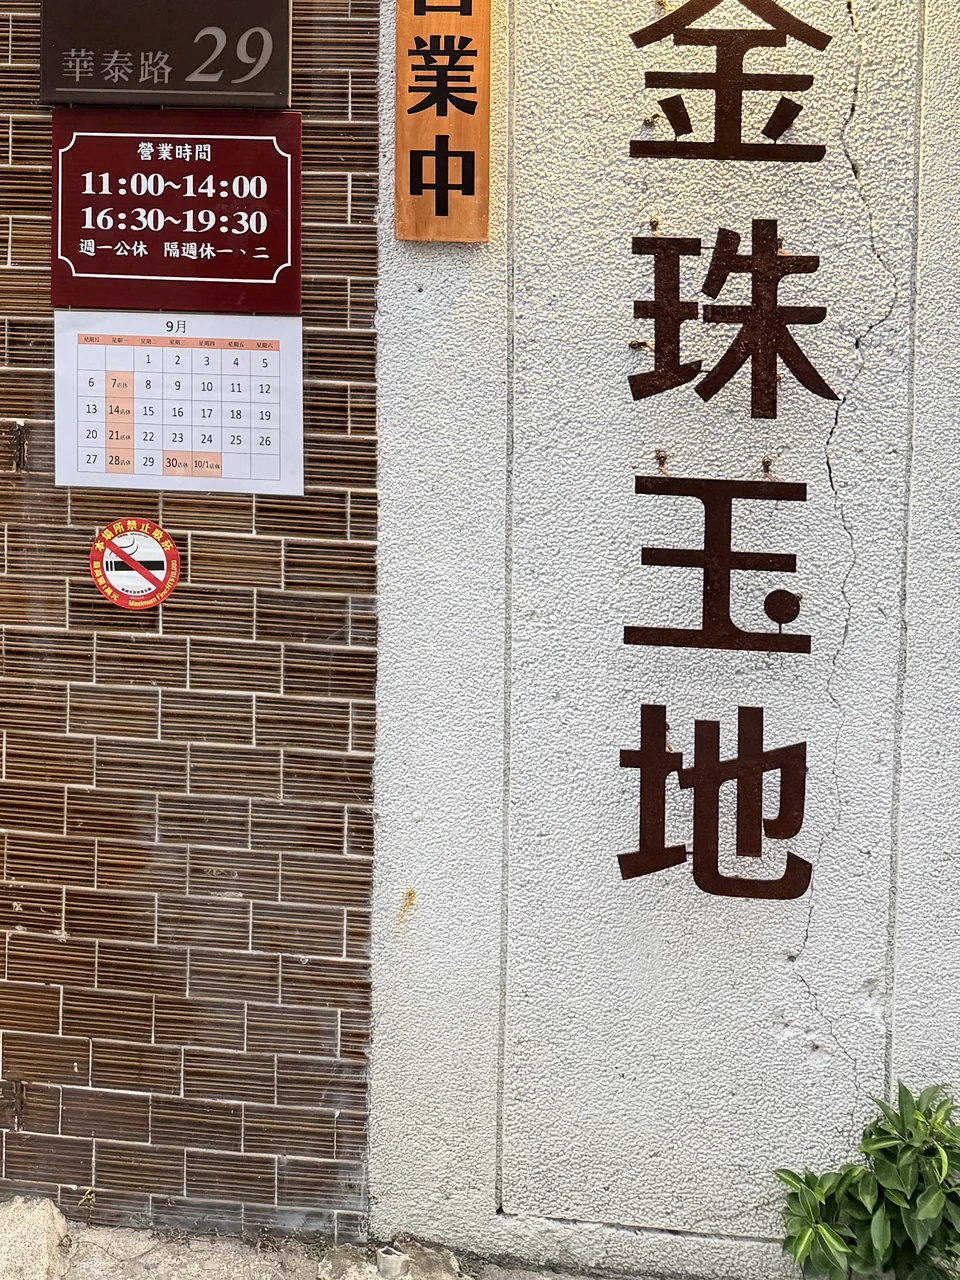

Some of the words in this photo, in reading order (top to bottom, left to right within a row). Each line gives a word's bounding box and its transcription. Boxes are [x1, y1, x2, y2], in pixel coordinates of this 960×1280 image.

[61, 48, 173, 84] 華泰路
[184, 26, 273, 84] 29
[137, 142, 212, 162] 營業時間
[81, 171, 267, 199] 11:00~14:00
[81, 206, 267, 235] 16:30~19:30
[79, 239, 148, 257] 週一公休
[165, 320, 186, 334] 9月
[146, 354, 151, 364] 1
[175, 355, 181, 365] 2
[204, 356, 210, 366] 3
[233, 357, 239, 367] 4
[262, 358, 268, 368] 5
[88, 377, 95, 388] 6
[145, 379, 152, 389] 8
[174, 380, 181, 391] 9
[201, 381, 213, 392] 10
[230, 383, 242, 393] 11
[259, 383, 271, 394] 12
[86, 404, 98, 414] 13
[142, 406, 154, 416] 15
[172, 407, 184, 417] 16
[201, 409, 213, 418] 17
[230, 410, 242, 419] 18
[259, 411, 271, 421] 19
[86, 429, 98, 439] 20
[142, 431, 154, 441] 22
[172, 432, 184, 443] 23
[201, 434, 212, 444] 24
[230, 435, 242, 445] 25
[259, 436, 271, 446] 26
[86, 454, 98, 464] 27
[142, 457, 154, 467] 29
